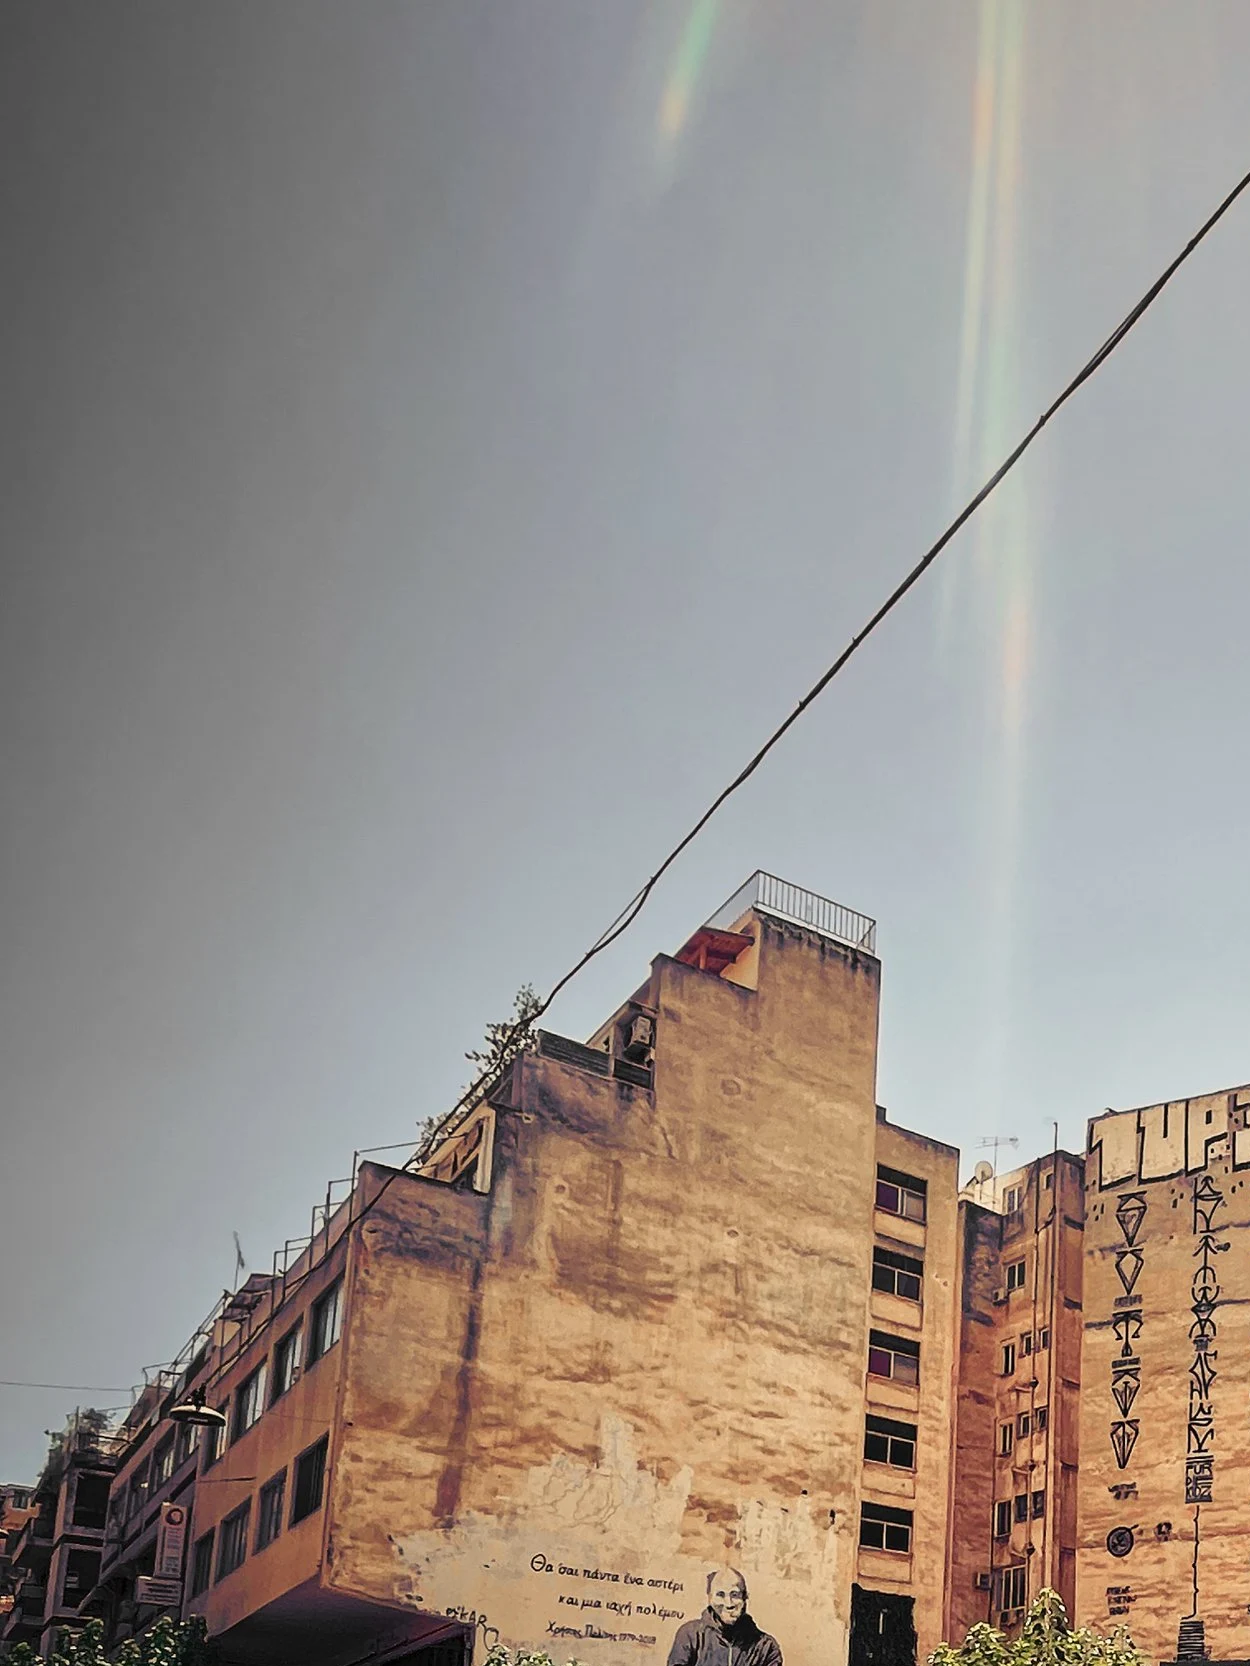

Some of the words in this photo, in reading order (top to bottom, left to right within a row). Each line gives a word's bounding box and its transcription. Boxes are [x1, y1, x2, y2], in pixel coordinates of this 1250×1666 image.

[531, 1554, 553, 1572] Θα
[583, 1568, 619, 1582] πάντα
[647, 1578, 683, 1594] αστέρι
[558, 1594, 578, 1606] και
[636, 1603, 684, 1621] πολέμου
